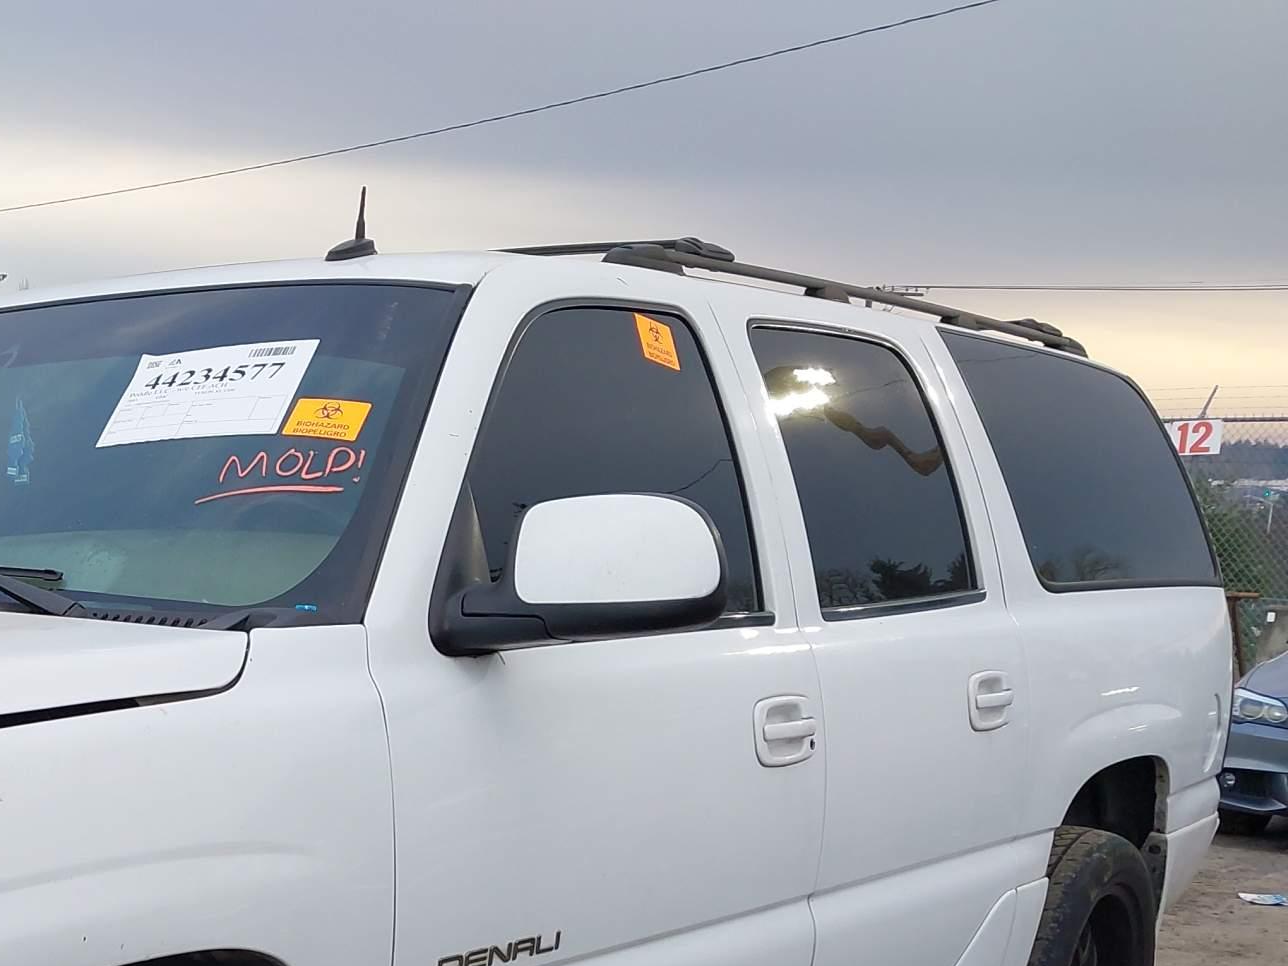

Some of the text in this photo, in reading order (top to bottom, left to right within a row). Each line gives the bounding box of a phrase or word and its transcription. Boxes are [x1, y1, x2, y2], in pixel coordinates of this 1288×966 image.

[144, 362, 286, 390] 44234577
[292, 427, 347, 438] BIOPELIGRO
[296, 420, 350, 430] BIOHAZARD
[1177, 421, 1213, 454] 12
[218, 446, 366, 483] MOLD!
